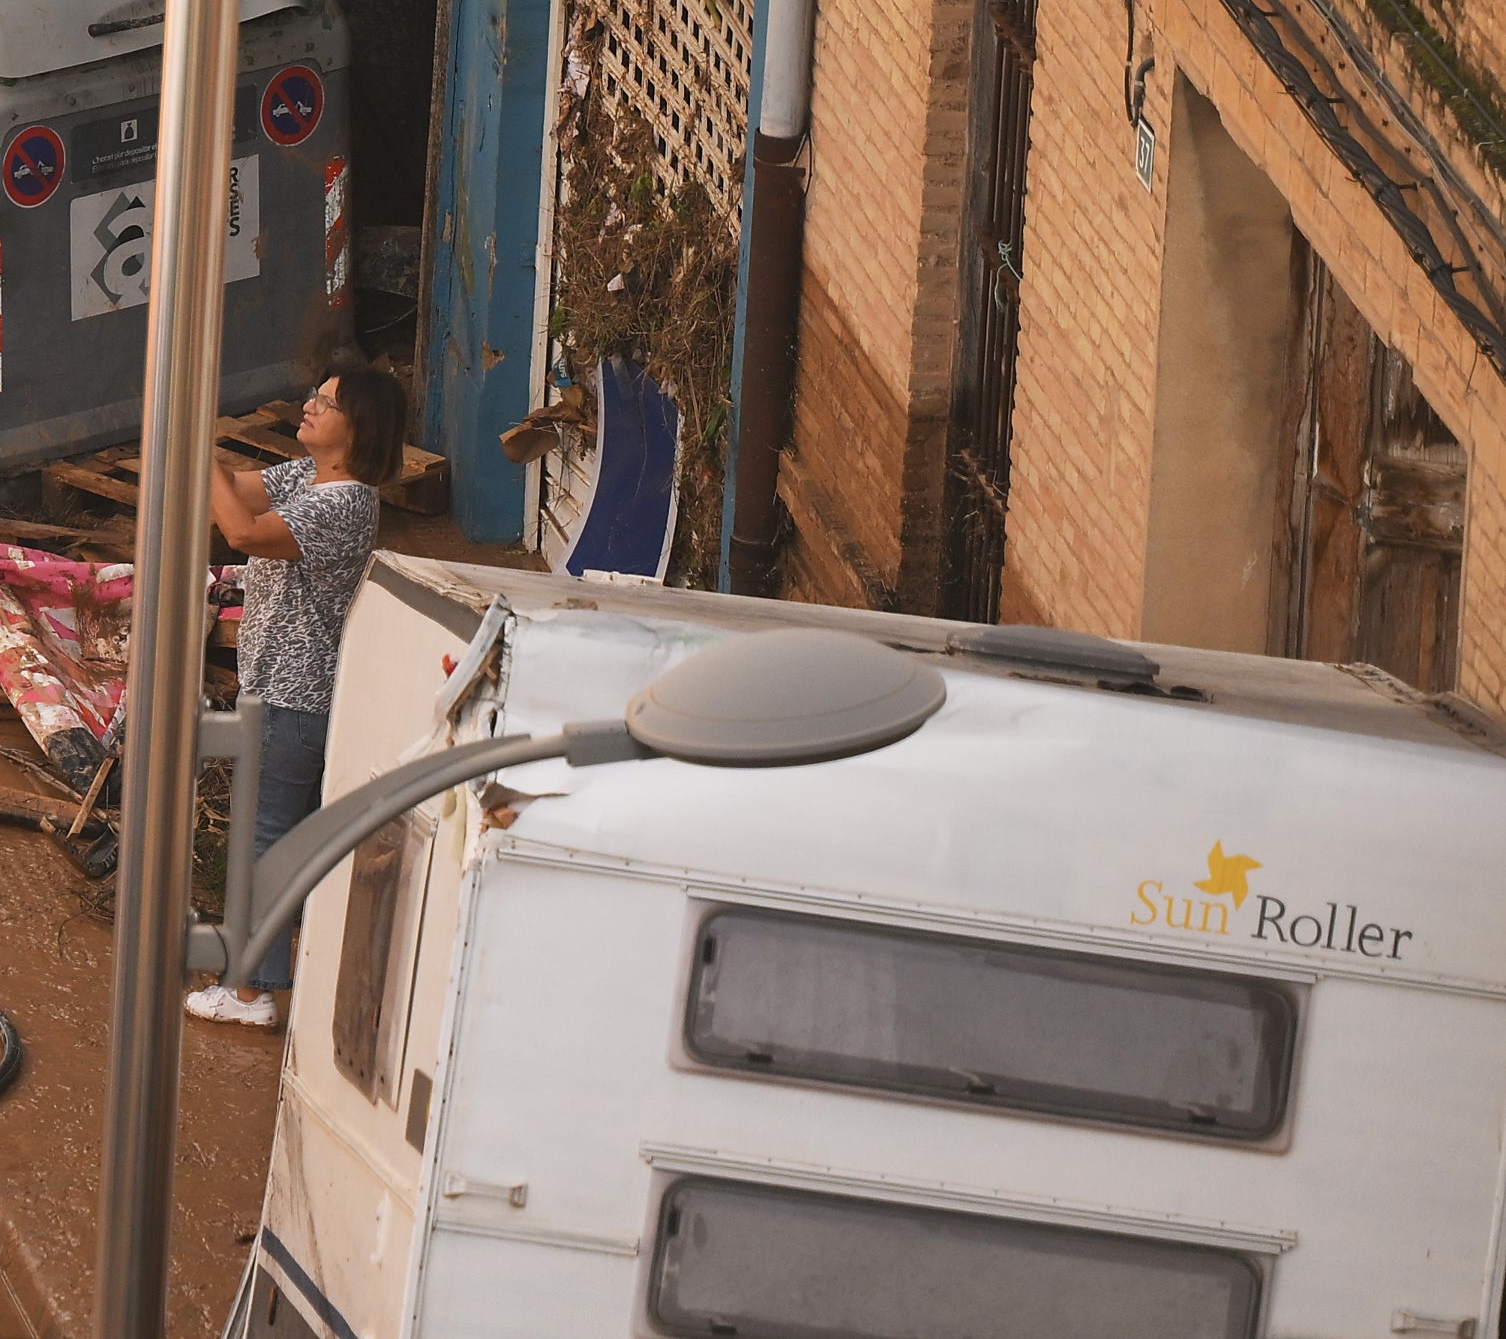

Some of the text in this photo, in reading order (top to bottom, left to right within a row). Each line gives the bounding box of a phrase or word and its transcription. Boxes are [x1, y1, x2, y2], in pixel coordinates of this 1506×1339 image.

[1139, 136, 1150, 174] 37
[1129, 878, 1414, 964] Sun Roller
